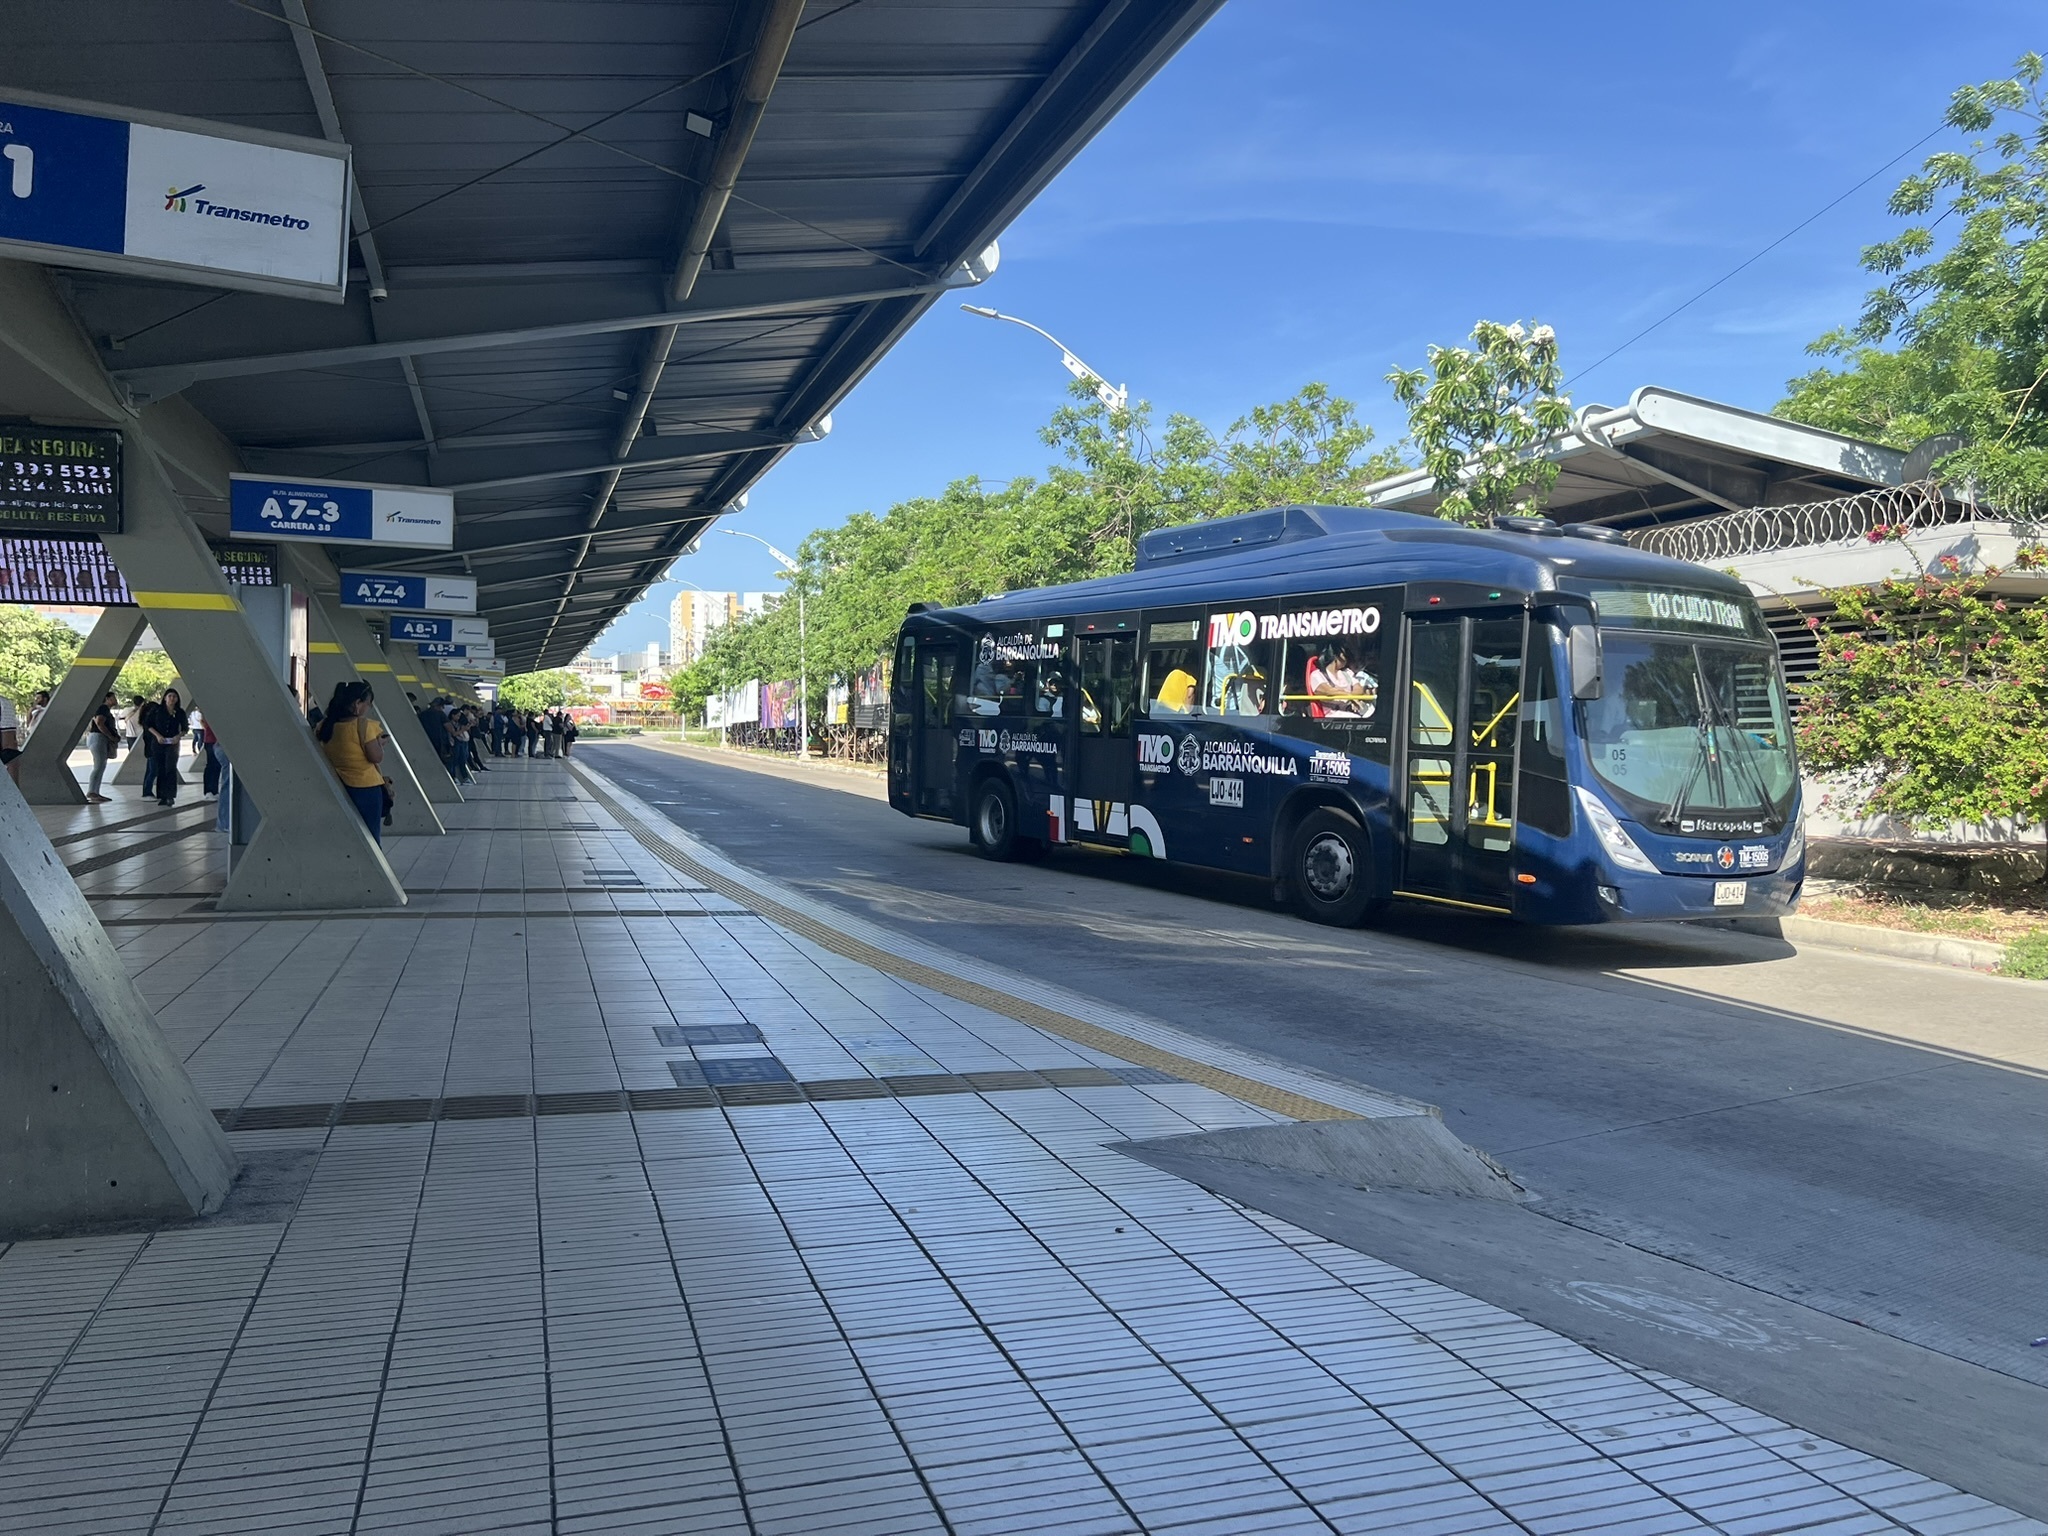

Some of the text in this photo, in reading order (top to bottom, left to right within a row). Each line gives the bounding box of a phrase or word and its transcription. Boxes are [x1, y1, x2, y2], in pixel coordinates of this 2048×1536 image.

[195, 199, 310, 231] Transmetro
[30, 438, 105, 459] SEGURA:
[47, 512, 106, 523] RESERVA
[270, 520, 316, 531] CARRERA
[397, 515, 442, 525] Transmetro
[1647, 592, 1671, 618] YO
[1671, 593, 1713, 622] CUIDO
[1208, 610, 1257, 648] TMO
[997, 632, 1033, 646] ALCALDÍA DE
[995, 643, 1059, 660] BARRANQUILLA
[978, 729, 997, 748] TMO
[1203, 739, 1255, 755] ALCALDÍA DE
[1011, 741, 1058, 754] BARRANQUILLA
[1137, 734, 1175, 764] TMO
[1612, 749, 1626, 760] 05
[1202, 754, 1298, 776] BARRANQUILLA
[1309, 759, 1351, 776] TM-15005
[1675, 852, 1713, 863] SCANIA
